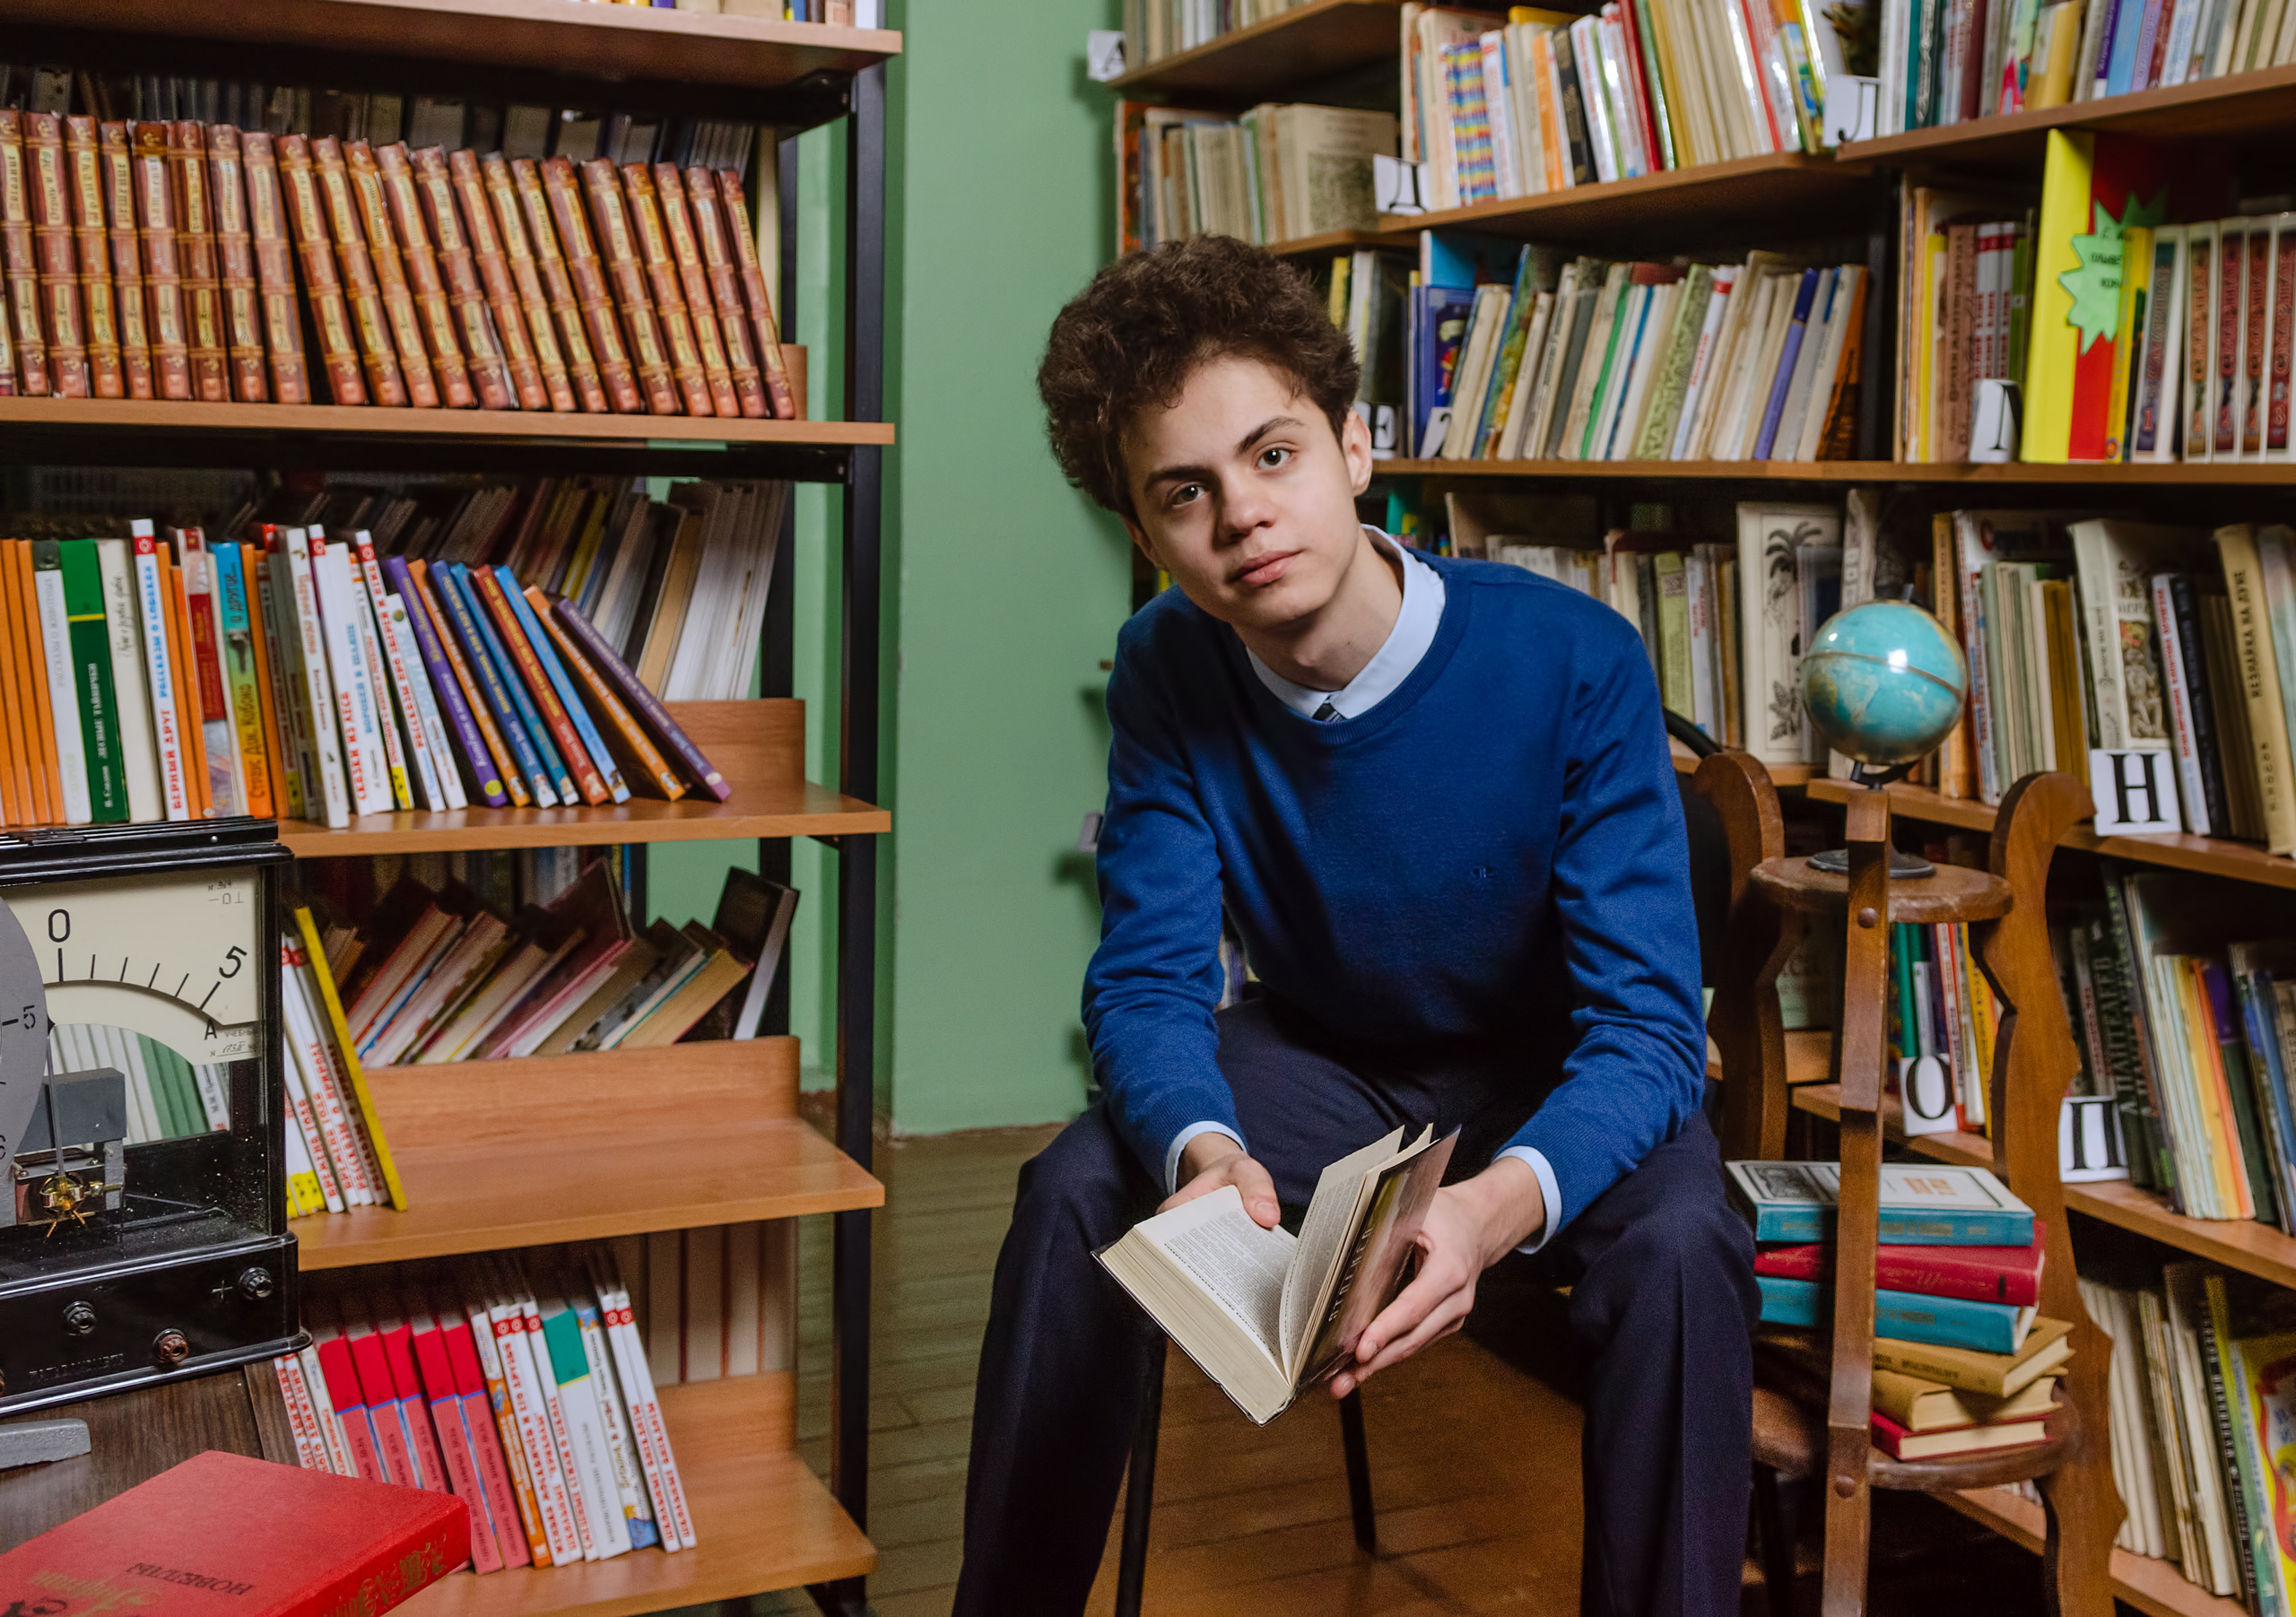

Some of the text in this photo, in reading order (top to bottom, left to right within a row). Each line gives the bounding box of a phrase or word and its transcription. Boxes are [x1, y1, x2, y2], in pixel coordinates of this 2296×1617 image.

[294, 573, 317, 616] Первая
[42, 577, 65, 686] РАССКАЗЫ О ЖИВОТНЫХ
[366, 563, 425, 748] РАССКАЗЫ ПРО ЗВЕРЕЙ И ПТИЦ
[2231, 569, 2264, 699] НЕЗНАЙКА НА ЛУНЕ
[85, 662, 102, 716] ТАЙНИЧКИ
[142, 564, 183, 810] ВЕРНЫЙ ДРУГ РАССКАЗЫ О СОБАКАХ
[362, 634, 381, 674] РАССКАЗЫ
[381, 719, 400, 764] ЖИВОТНЫХ
[2154, 587, 2192, 758] ПРИКЛЮЧЕНИЯ КАПИТАНА ВРУНГЕЛЯ
[93, 717, 108, 760] ЛЕСНЫЕ
[337, 690, 368, 801] СКАЗКИ ИЗ ЛЕСА
[2258, 741, 2276, 795] НОСОВ
[2107, 753, 2169, 823] Н
[48, 909, 70, 943] 0
[219, 945, 248, 978] 5
[308, 1041, 367, 1190] РАССКАЗЫ О ПРИРОДЕ
[326, 1042, 383, 1191] РАССКАЗЫ О ПРИРОДЕ
[1906, 1055, 1953, 1120] О
[296, 1098, 338, 1197] ВРЕМЕНА ГОДА
[311, 1091, 353, 1190] ВРЕМЕНА ГОДА
[2066, 1100, 2128, 1171] П
[501, 1341, 522, 1389] ДРУЗЬЯ
[290, 1368, 318, 1439] ДВИЖЕНИЯ
[515, 1391, 527, 1411] ЕГО
[521, 1415, 531, 1424] И
[548, 1396, 595, 1551] СМЕШНЫЕ СТИХИ О ШКОЛЕ
[631, 1403, 674, 1542] ШКОЛЬНЫЕ АНЕКДОТЫ
[646, 1401, 691, 1538] ШКОЛЬНЫЕ АНЕКДОТЫ
[552, 1483, 578, 1552] ШКОЛЬНЫЕ
[126, 1562, 255, 1595] НОВЕЛЛЫ
